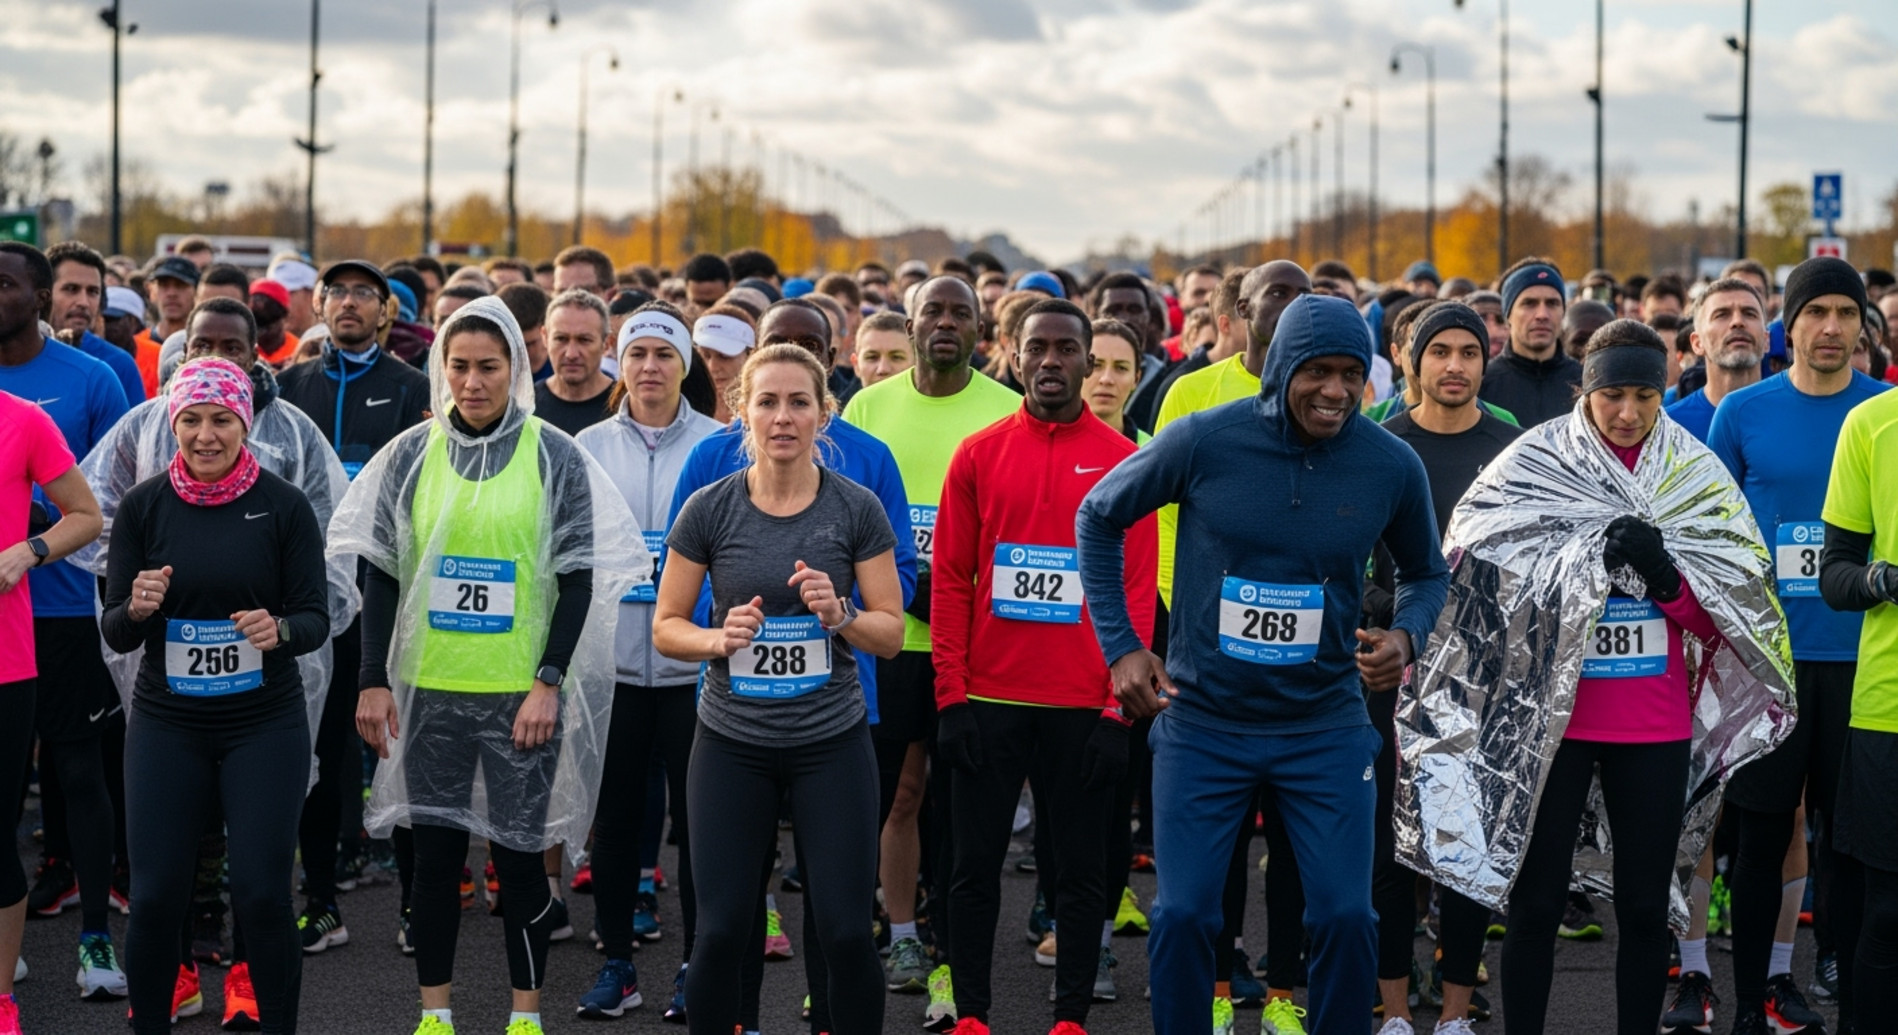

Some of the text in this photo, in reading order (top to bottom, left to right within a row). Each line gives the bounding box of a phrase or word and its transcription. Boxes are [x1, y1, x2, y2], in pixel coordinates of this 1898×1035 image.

[456, 583, 489, 613] 26
[1014, 570, 1064, 602] 842
[1241, 608, 1298, 643] 268
[187, 644, 240, 676] 256
[753, 644, 806, 676] 288
